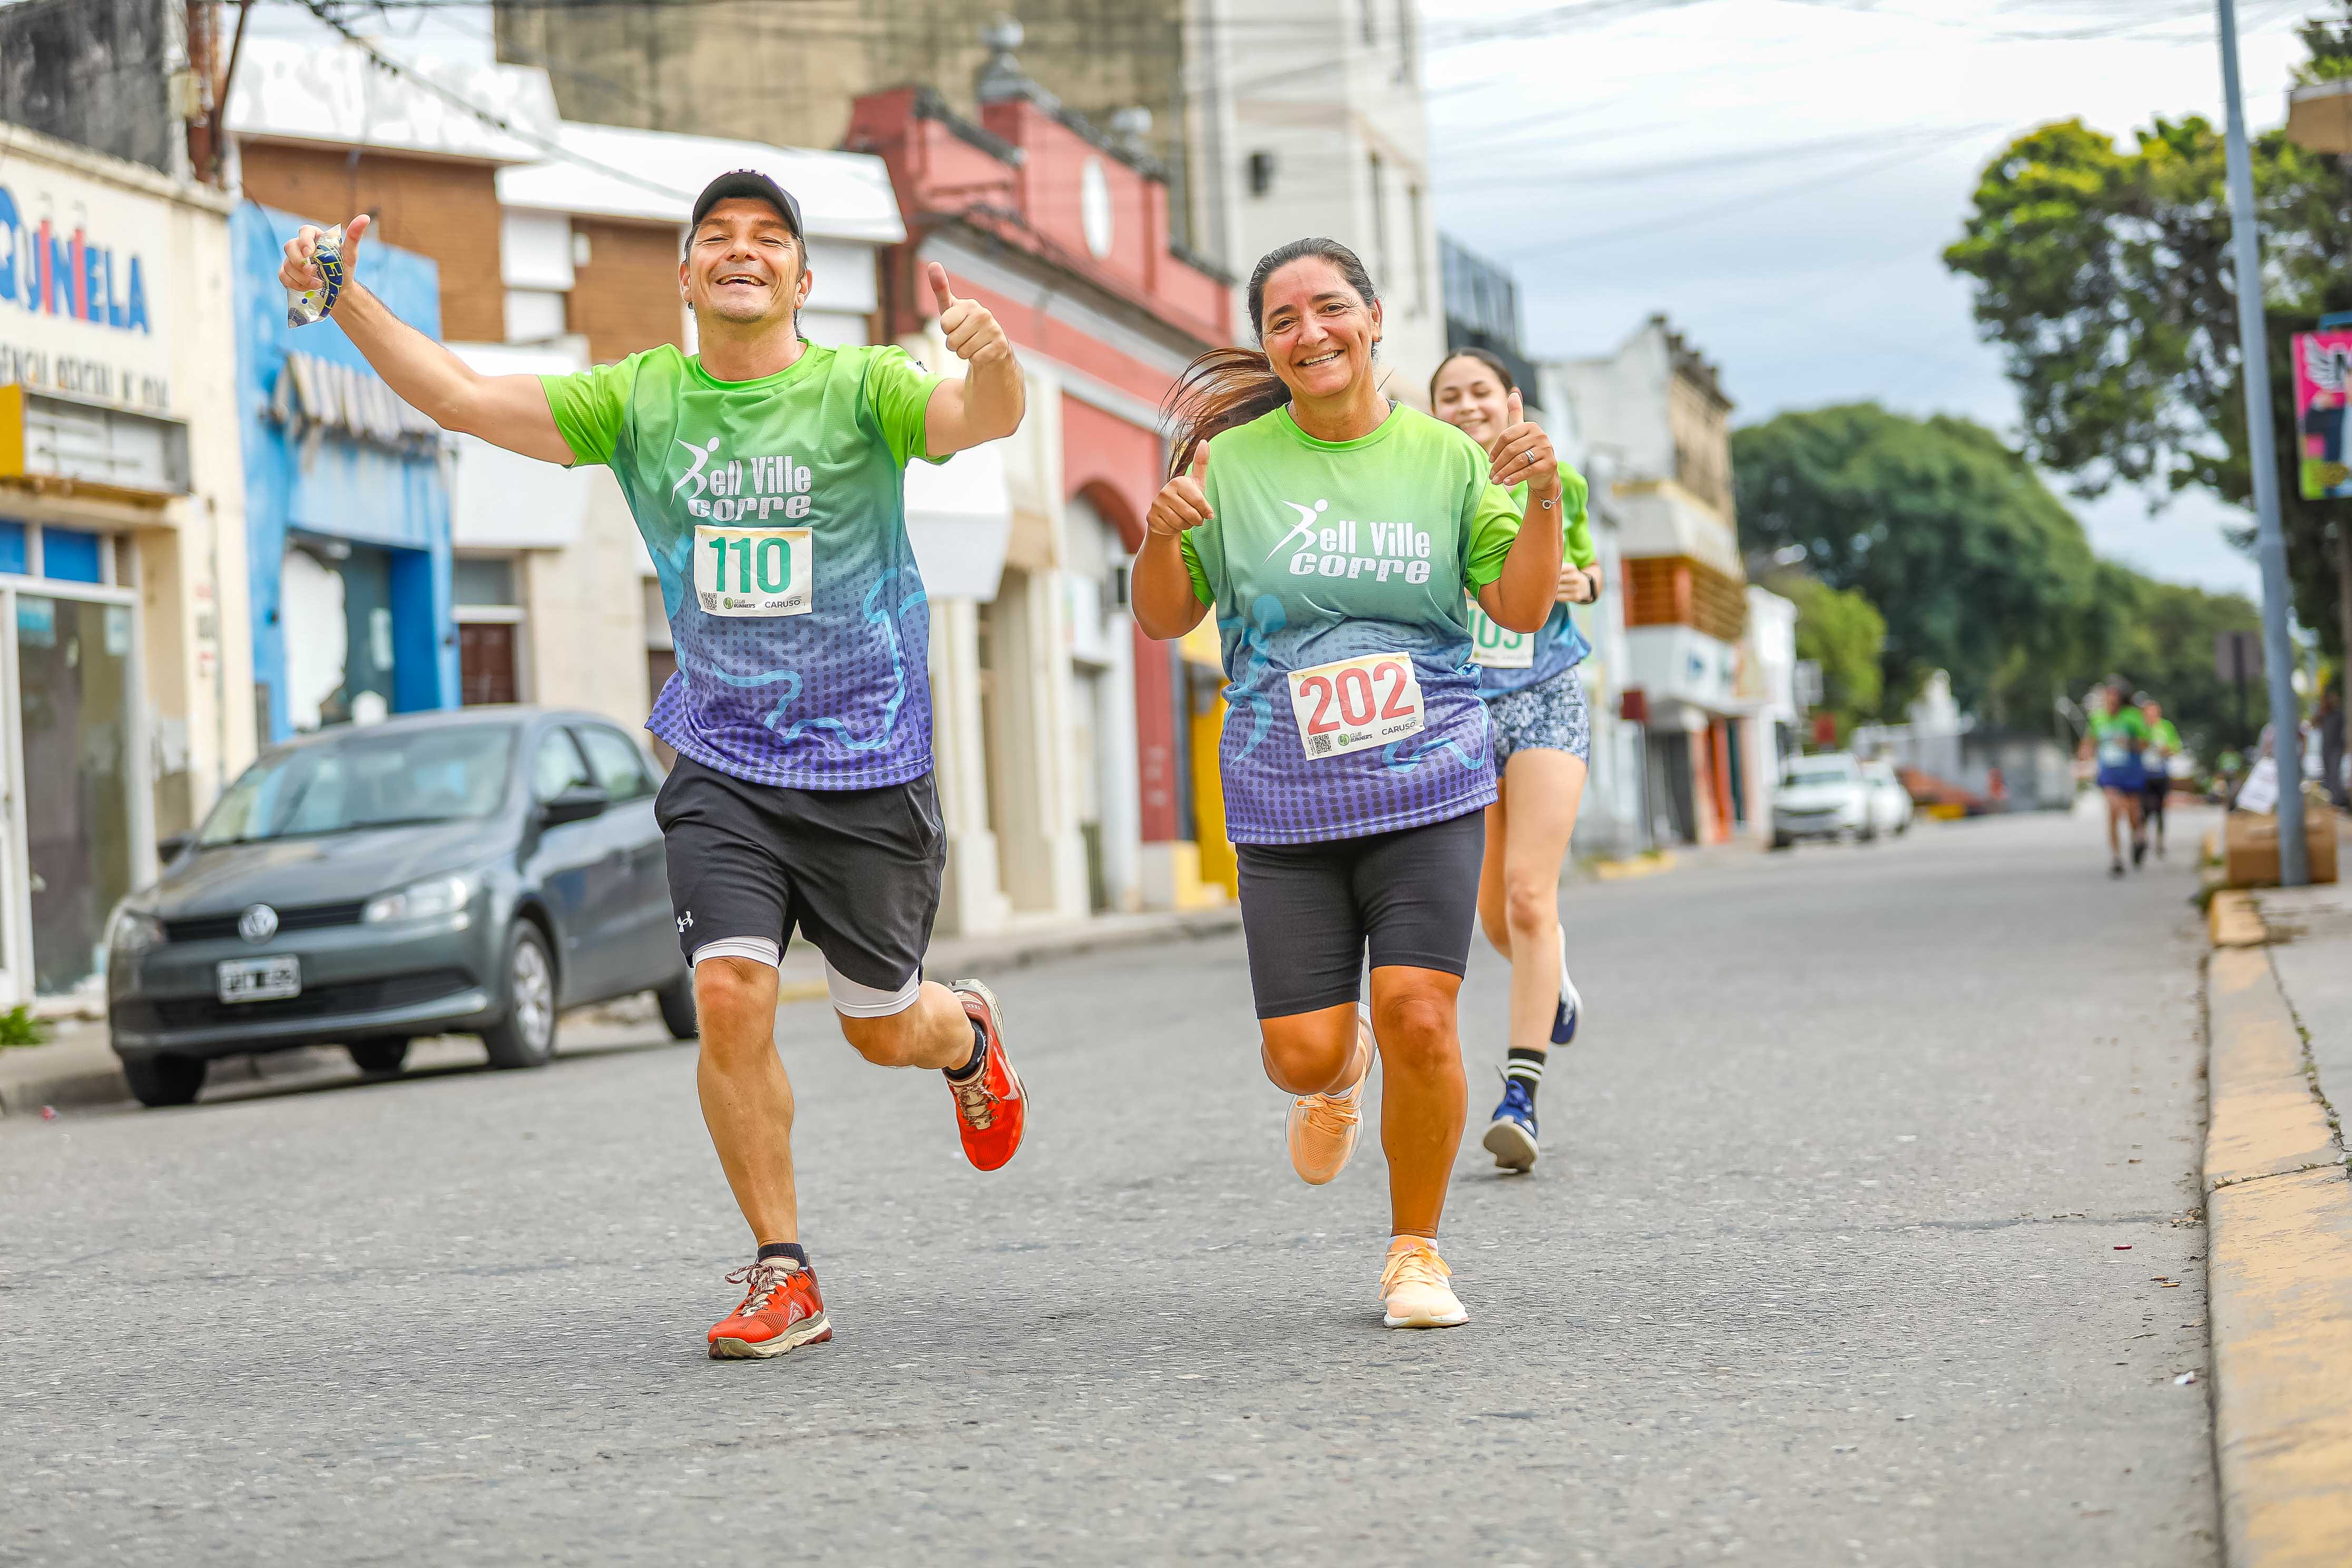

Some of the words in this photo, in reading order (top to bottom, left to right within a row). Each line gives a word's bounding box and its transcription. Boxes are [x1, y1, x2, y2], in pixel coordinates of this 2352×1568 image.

[750, 455, 811, 494] Ville
[687, 495, 812, 522] corre
[1369, 522, 1430, 558] Ville
[709, 536, 791, 594] 110
[1289, 552, 1431, 584] corre
[765, 600, 800, 609] CARUSO
[1299, 661, 1415, 736] 202
[1350, 733, 1373, 743] RUNNER'S
[1381, 721, 1416, 736] CARUSO
